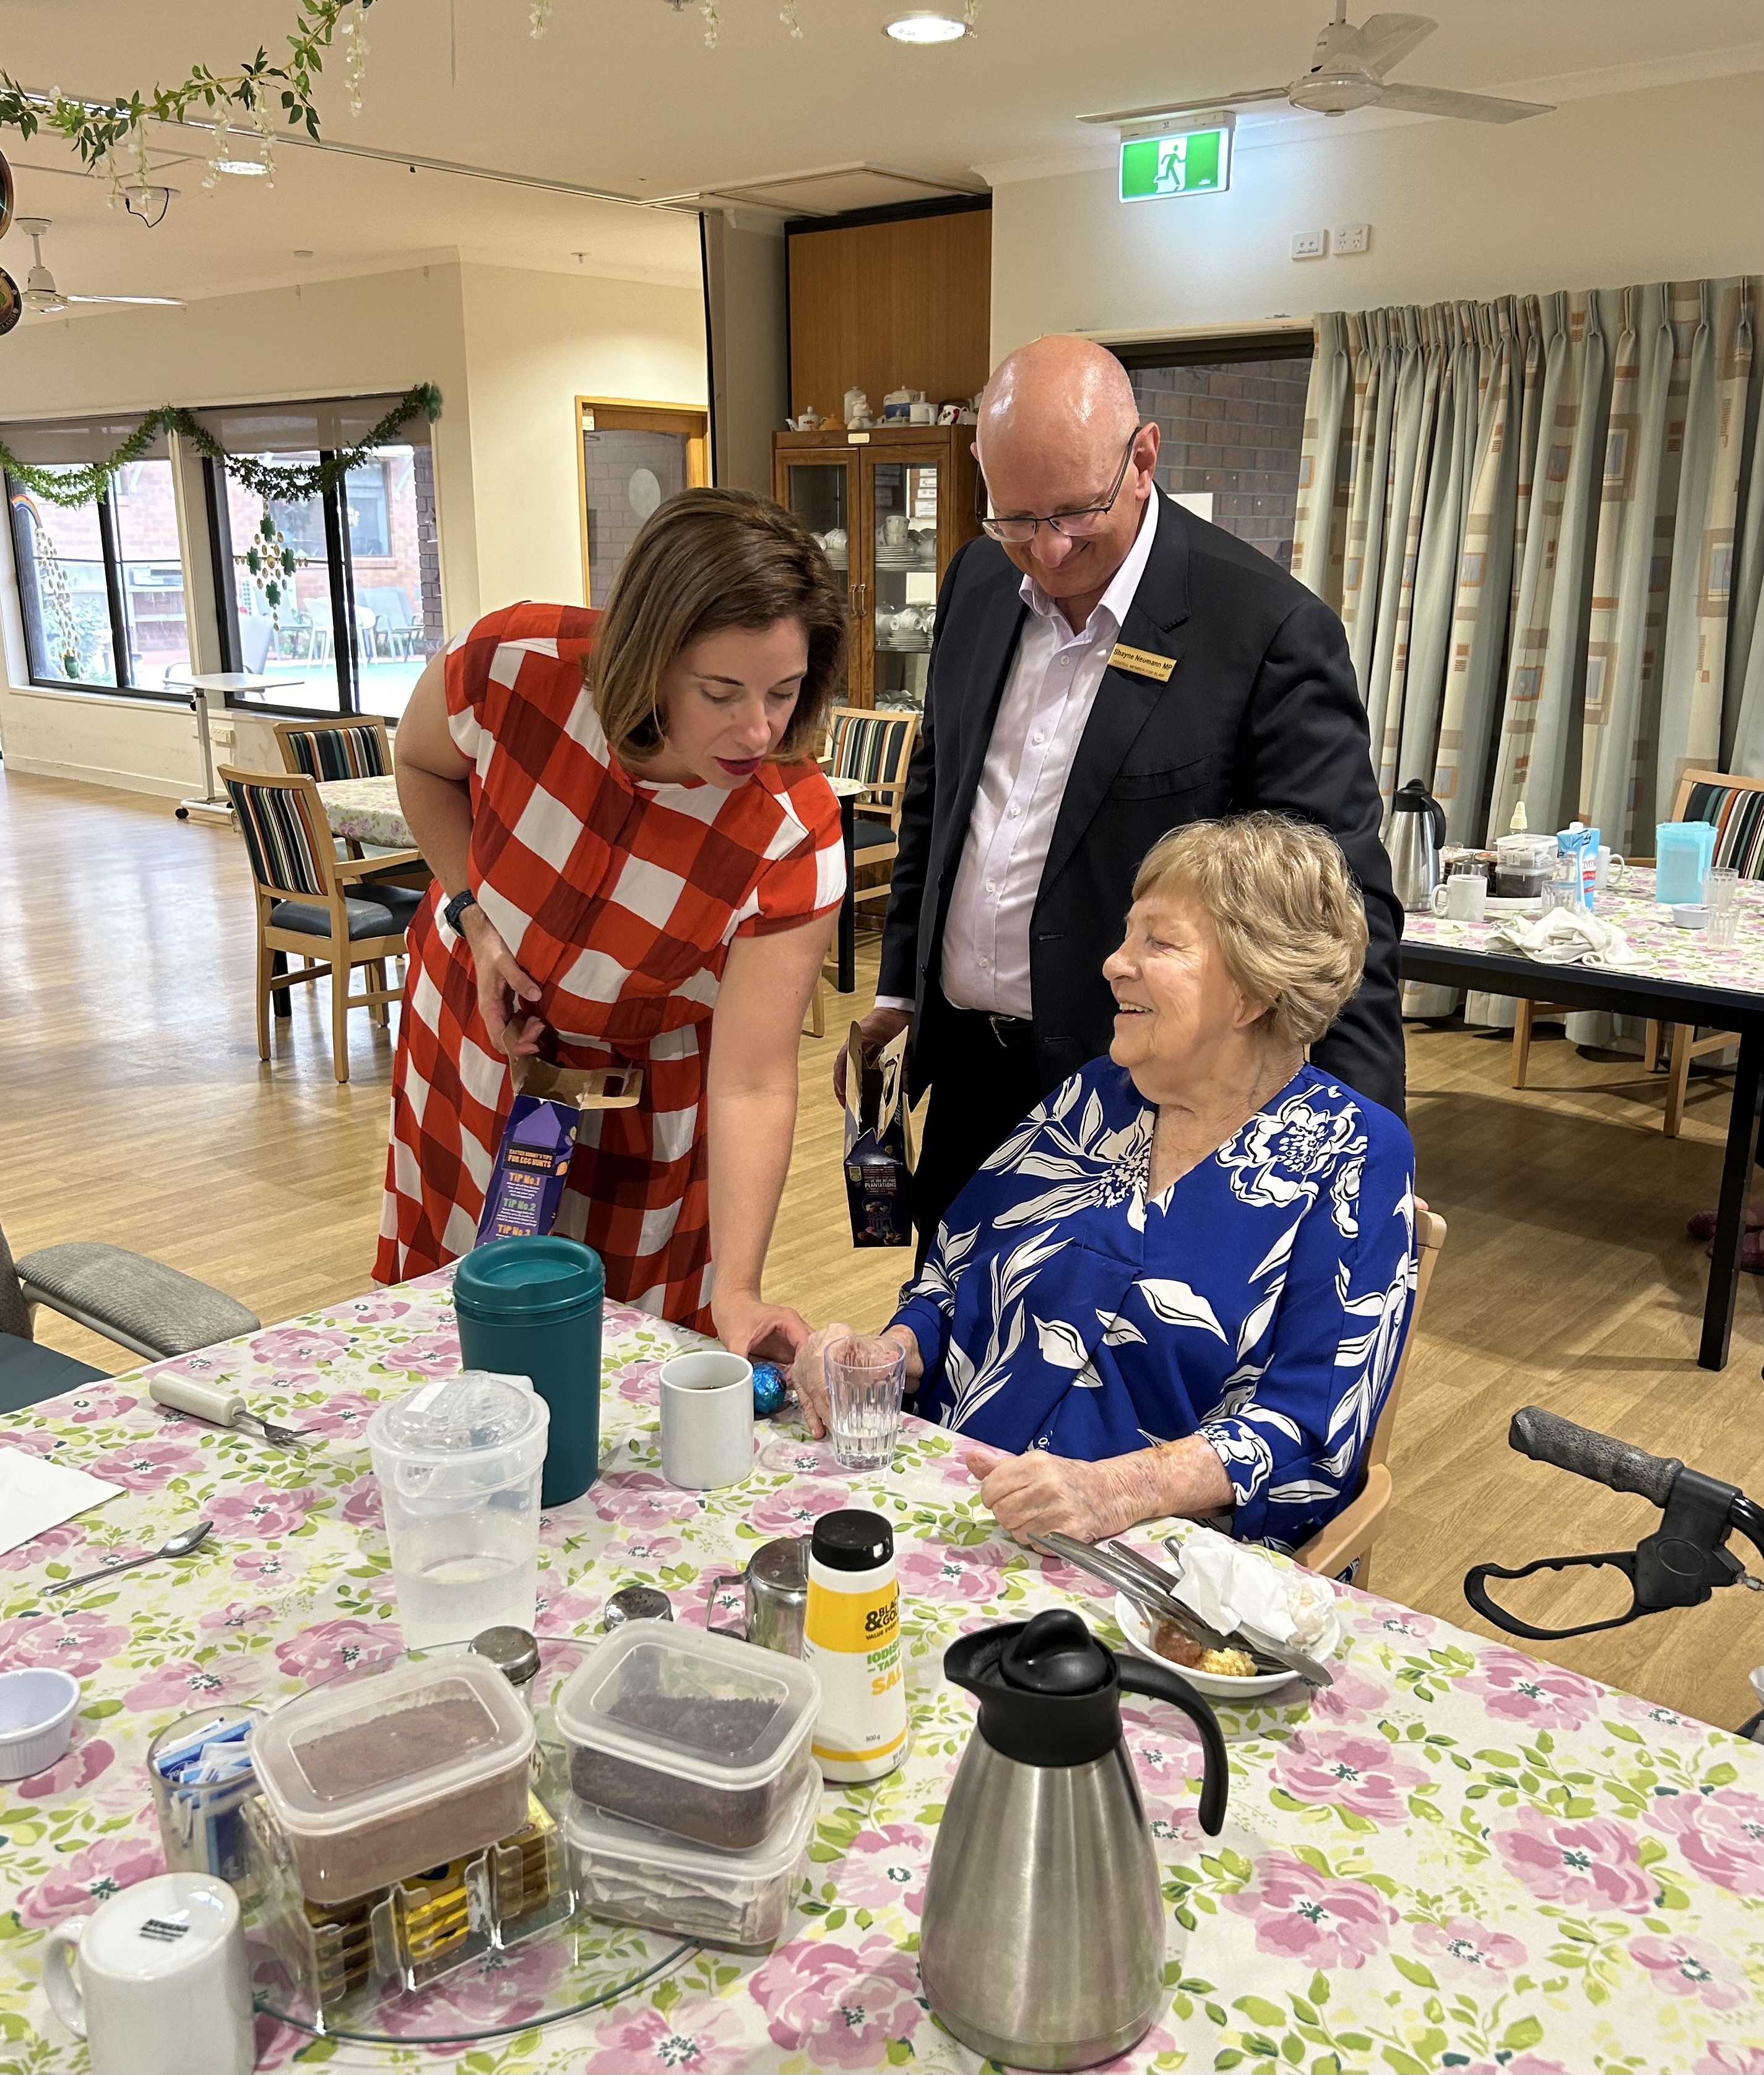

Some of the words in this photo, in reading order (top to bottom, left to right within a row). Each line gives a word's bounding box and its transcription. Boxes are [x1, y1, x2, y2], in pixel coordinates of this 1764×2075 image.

[1113, 649, 1134, 660] Shayne
[1135, 655, 1162, 668] Neumann
[879, 1597, 898, 1617] BLAC
[883, 1608, 897, 1625] GOL
[866, 1629, 884, 1640] VALUE
[871, 1663, 902, 1696] SAL
